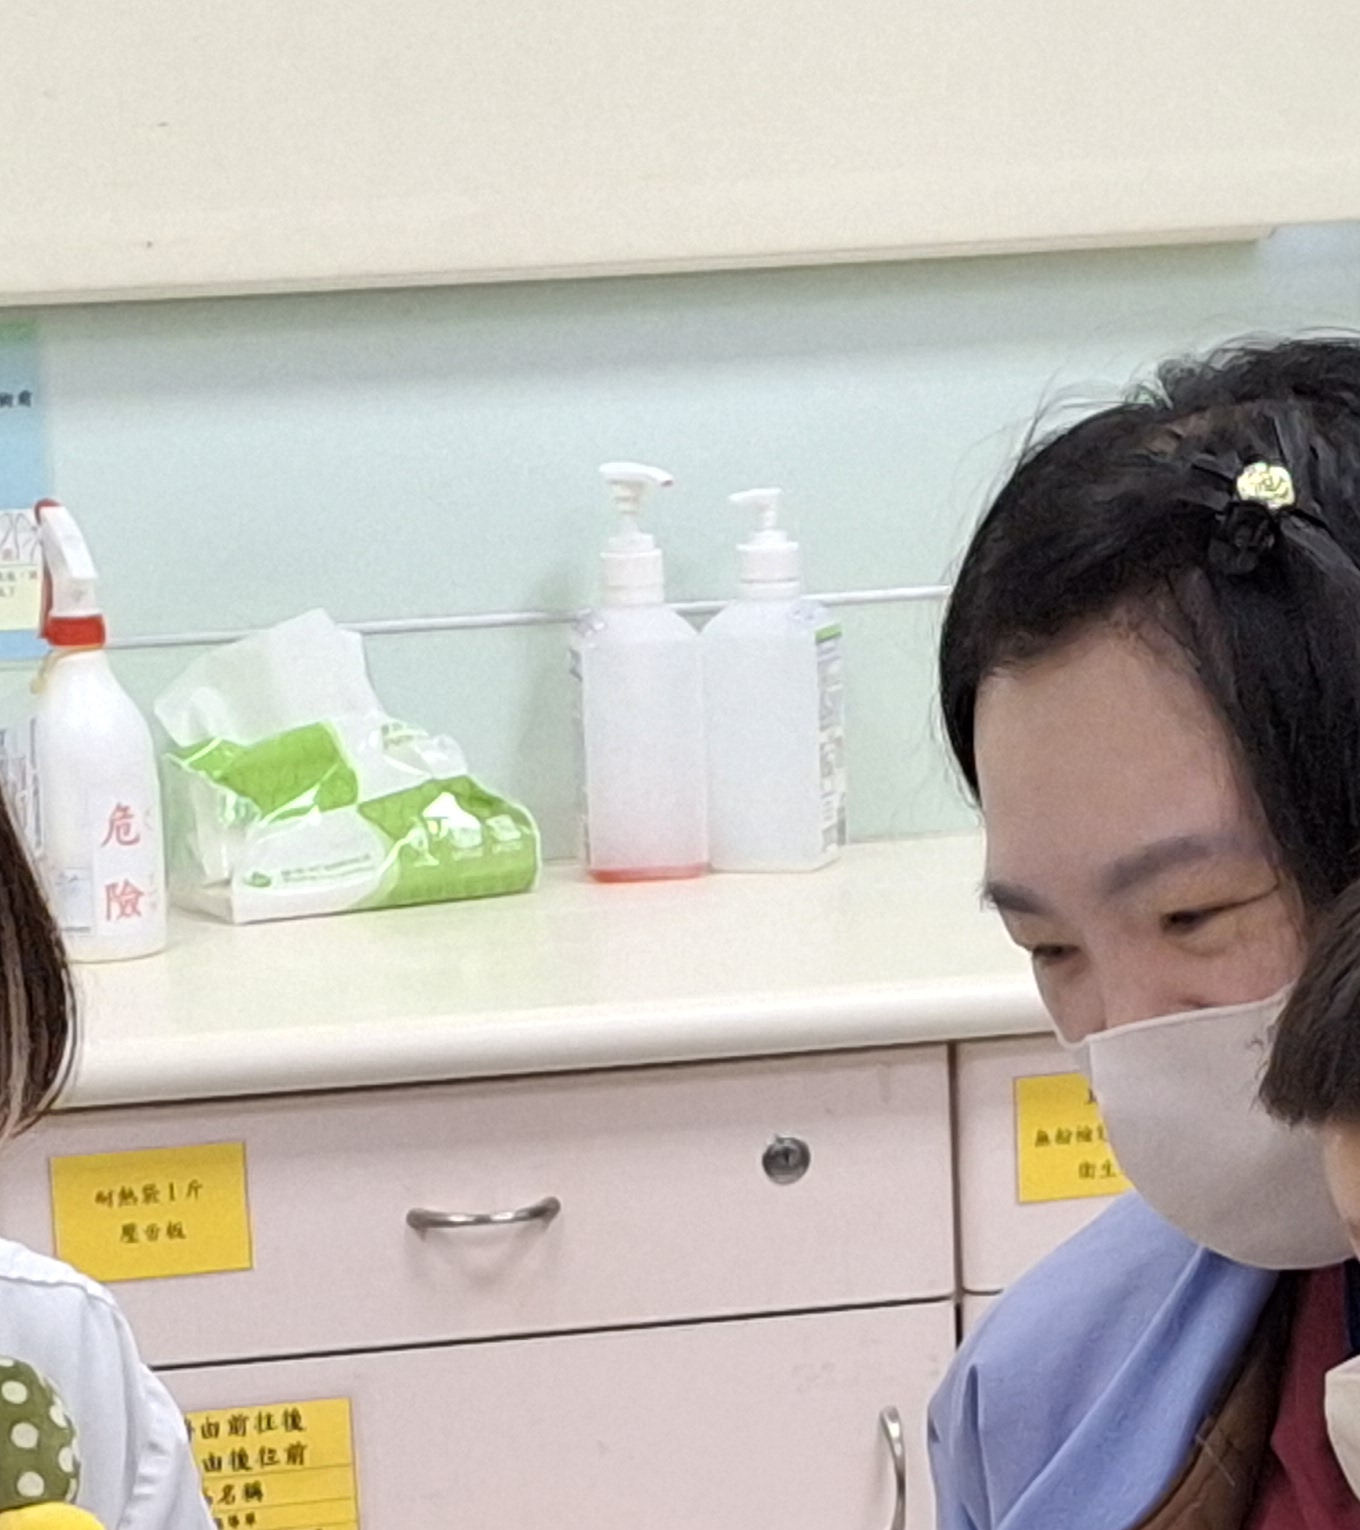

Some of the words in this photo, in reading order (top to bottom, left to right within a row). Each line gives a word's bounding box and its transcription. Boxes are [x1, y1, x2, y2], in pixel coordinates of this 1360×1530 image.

[101, 801, 145, 921] 危險
[186, 1408, 306, 1444] 由前往後
